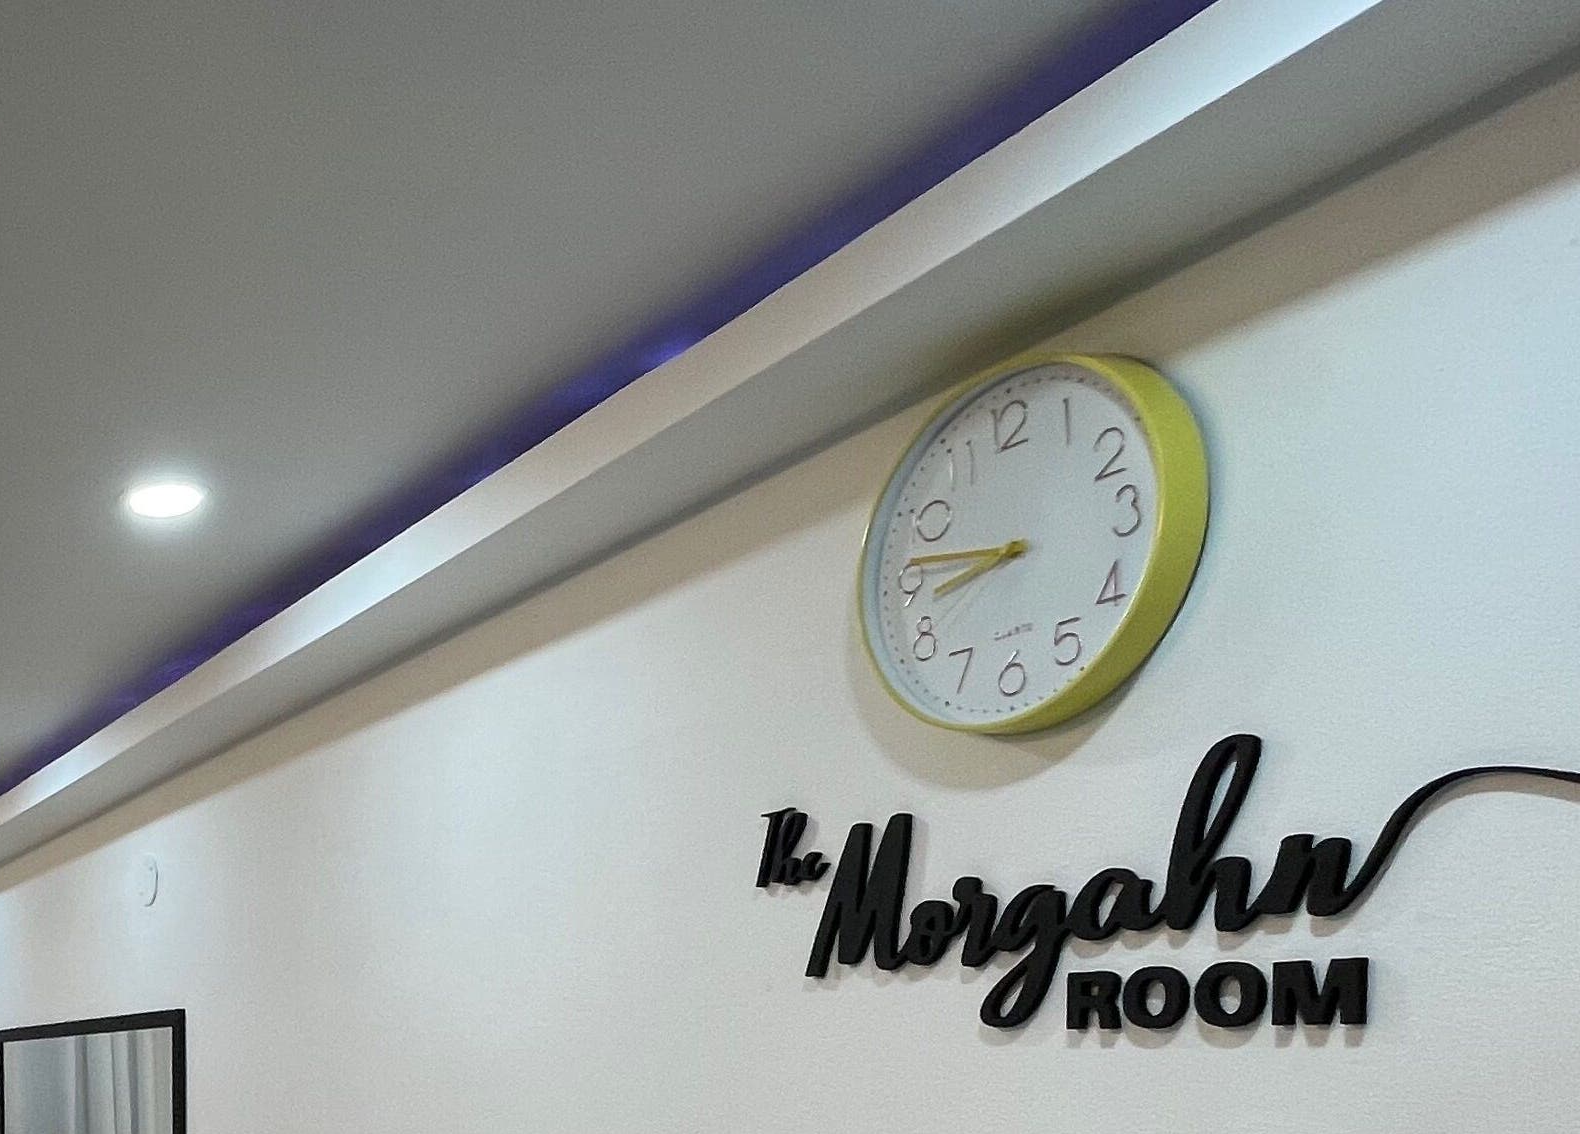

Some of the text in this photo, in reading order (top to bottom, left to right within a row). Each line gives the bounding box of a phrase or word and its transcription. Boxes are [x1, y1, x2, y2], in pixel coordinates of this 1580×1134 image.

[991, 400, 1028, 453] 12
[1063, 399, 1072, 446] 1
[1093, 427, 1126, 482] 2
[1112, 484, 1141, 537] 3
[898, 563, 923, 607] 9
[1096, 560, 1126, 607] 4
[913, 616, 937, 662] 8
[1053, 617, 1082, 665] 5
[948, 647, 974, 694] 7
[998, 649, 1027, 696] 6
[755, 733, 1454, 1030] The Morgahn
[1066, 957, 1369, 1030] ROOM
